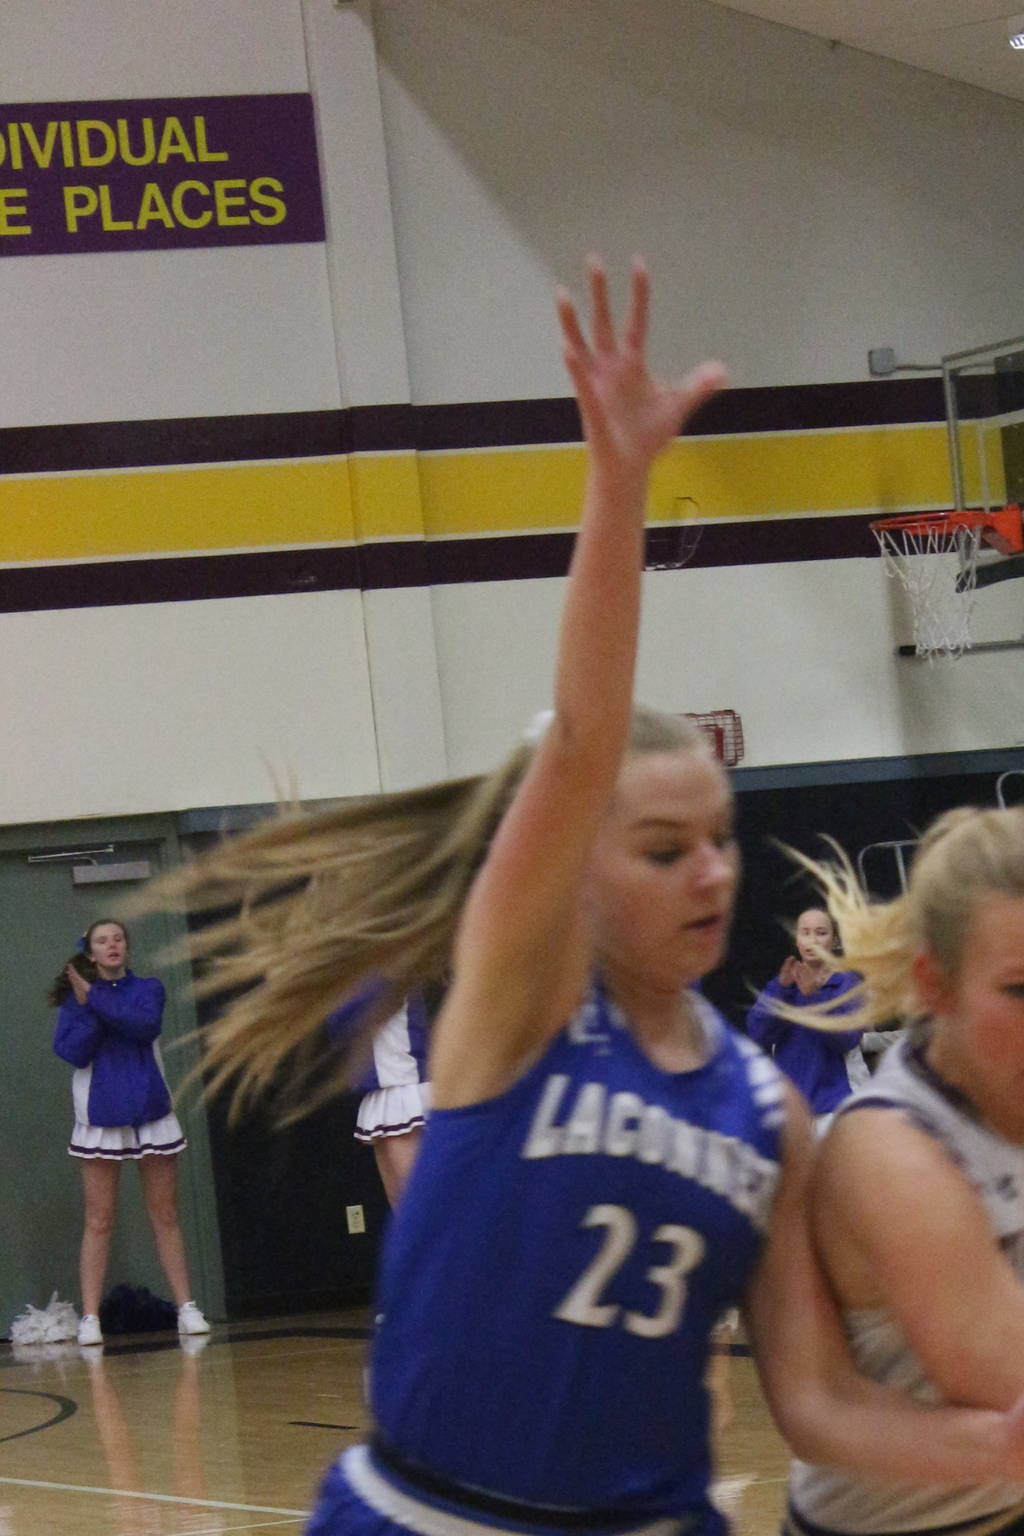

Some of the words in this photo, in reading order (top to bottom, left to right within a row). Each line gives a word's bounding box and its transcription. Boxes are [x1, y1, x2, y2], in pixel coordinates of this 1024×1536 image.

[0, 116, 229, 170] IVIDUAL
[63, 177, 287, 233] PLACES
[553, 1203, 705, 1339] 23
